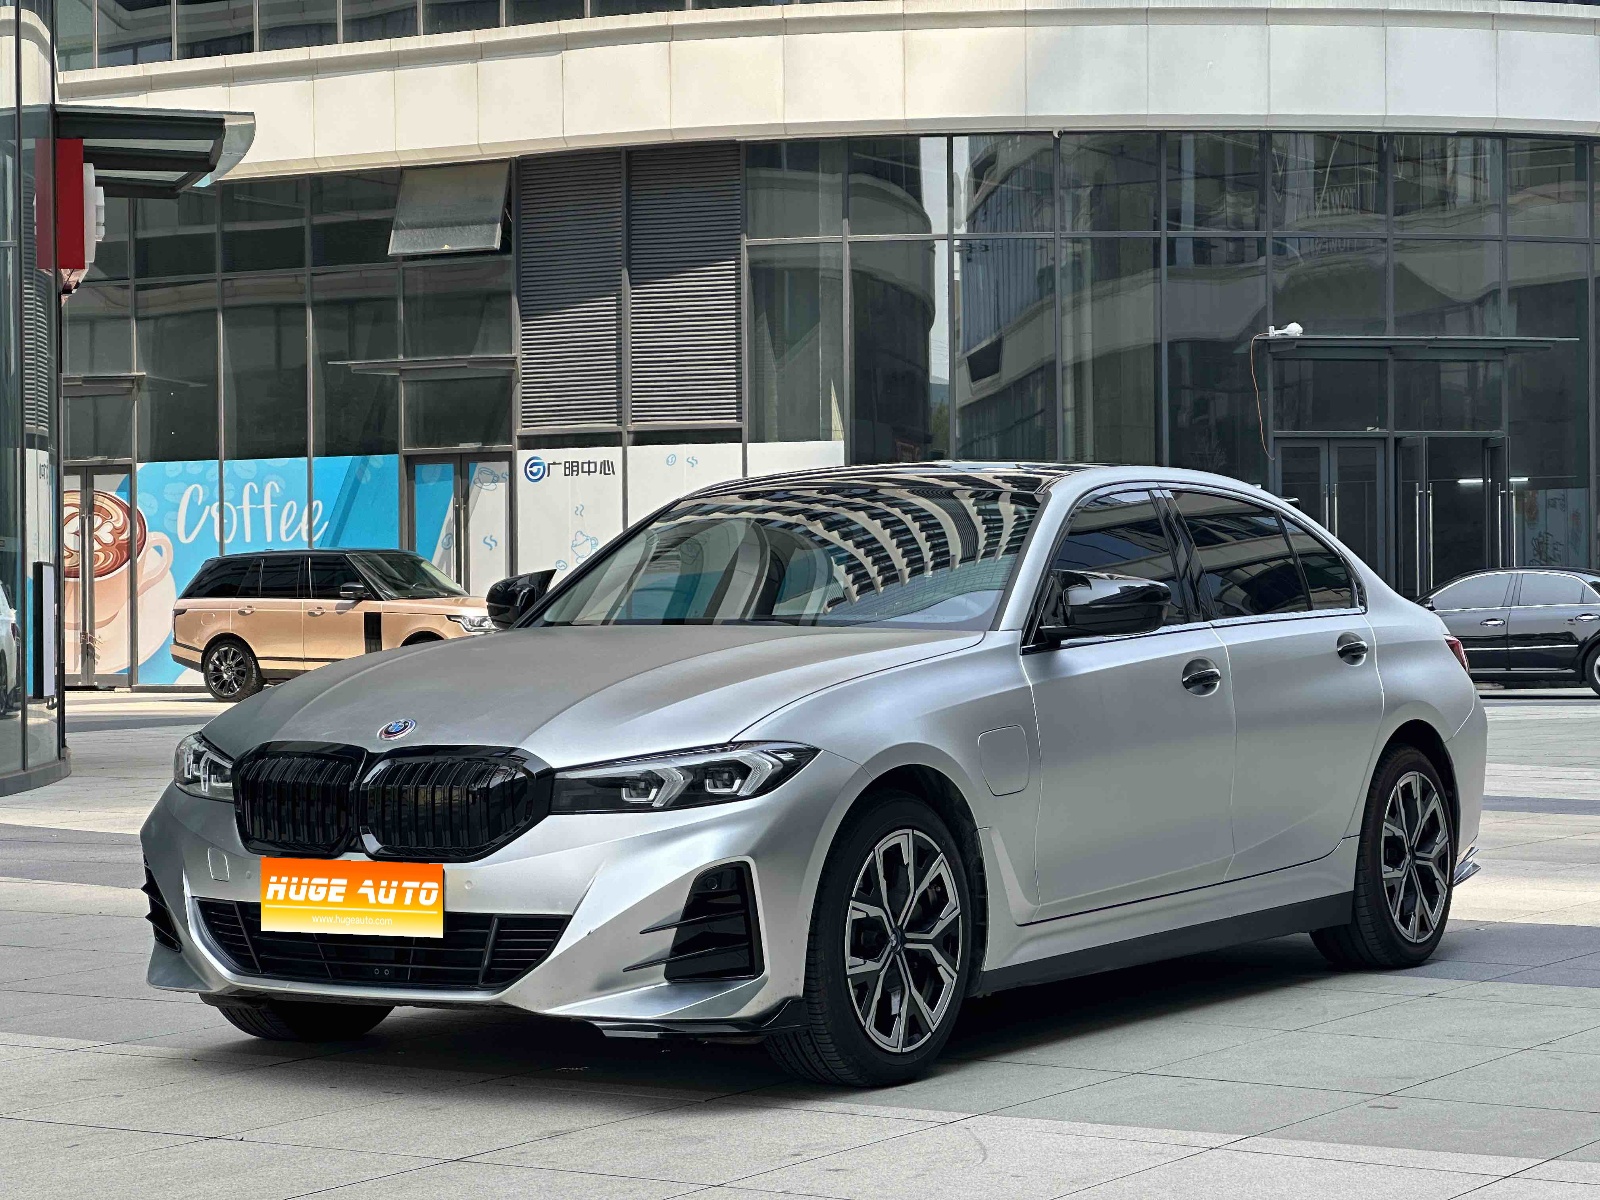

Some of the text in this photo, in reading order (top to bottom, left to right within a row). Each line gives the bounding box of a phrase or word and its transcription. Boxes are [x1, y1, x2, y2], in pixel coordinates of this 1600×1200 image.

[546, 460, 615, 477] 广明中心
[177, 481, 329, 544] Coffee
